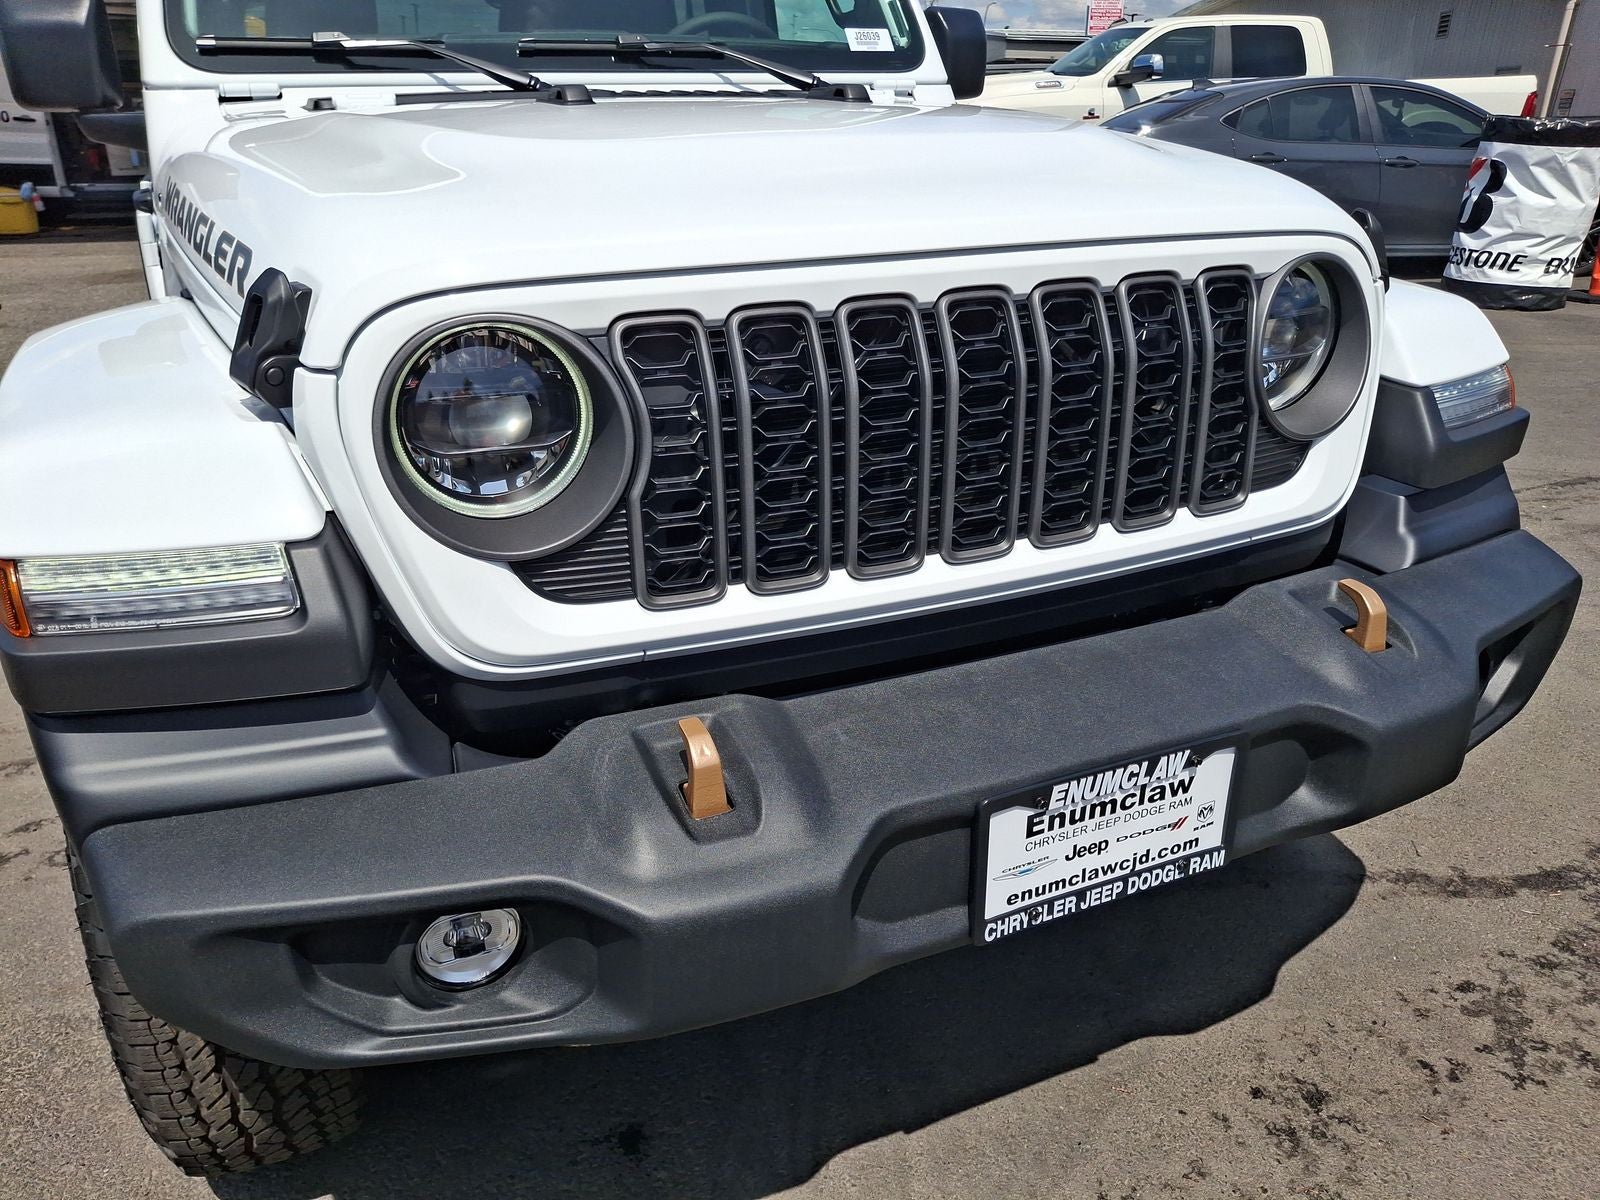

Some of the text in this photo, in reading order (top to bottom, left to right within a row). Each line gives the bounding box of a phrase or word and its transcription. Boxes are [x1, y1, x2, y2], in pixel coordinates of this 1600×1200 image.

[854, 31, 881, 41] J26039
[165, 175, 253, 300] WRANGLER
[1025, 775, 1195, 840] Enumclaw
[1048, 749, 1191, 811] ENUMCLAW
[1024, 796, 1193, 852] CHRYSLER JEEP DODGE RAM
[1064, 839, 1109, 862] Jeep
[1116, 821, 1178, 843] DODGE
[1193, 821, 1214, 832] RAM
[1001, 855, 1050, 874] CHRYSLER
[1006, 837, 1200, 906] enumclawcjd.com
[1080, 881, 1124, 909] JEEP
[1189, 849, 1225, 875] RAM
